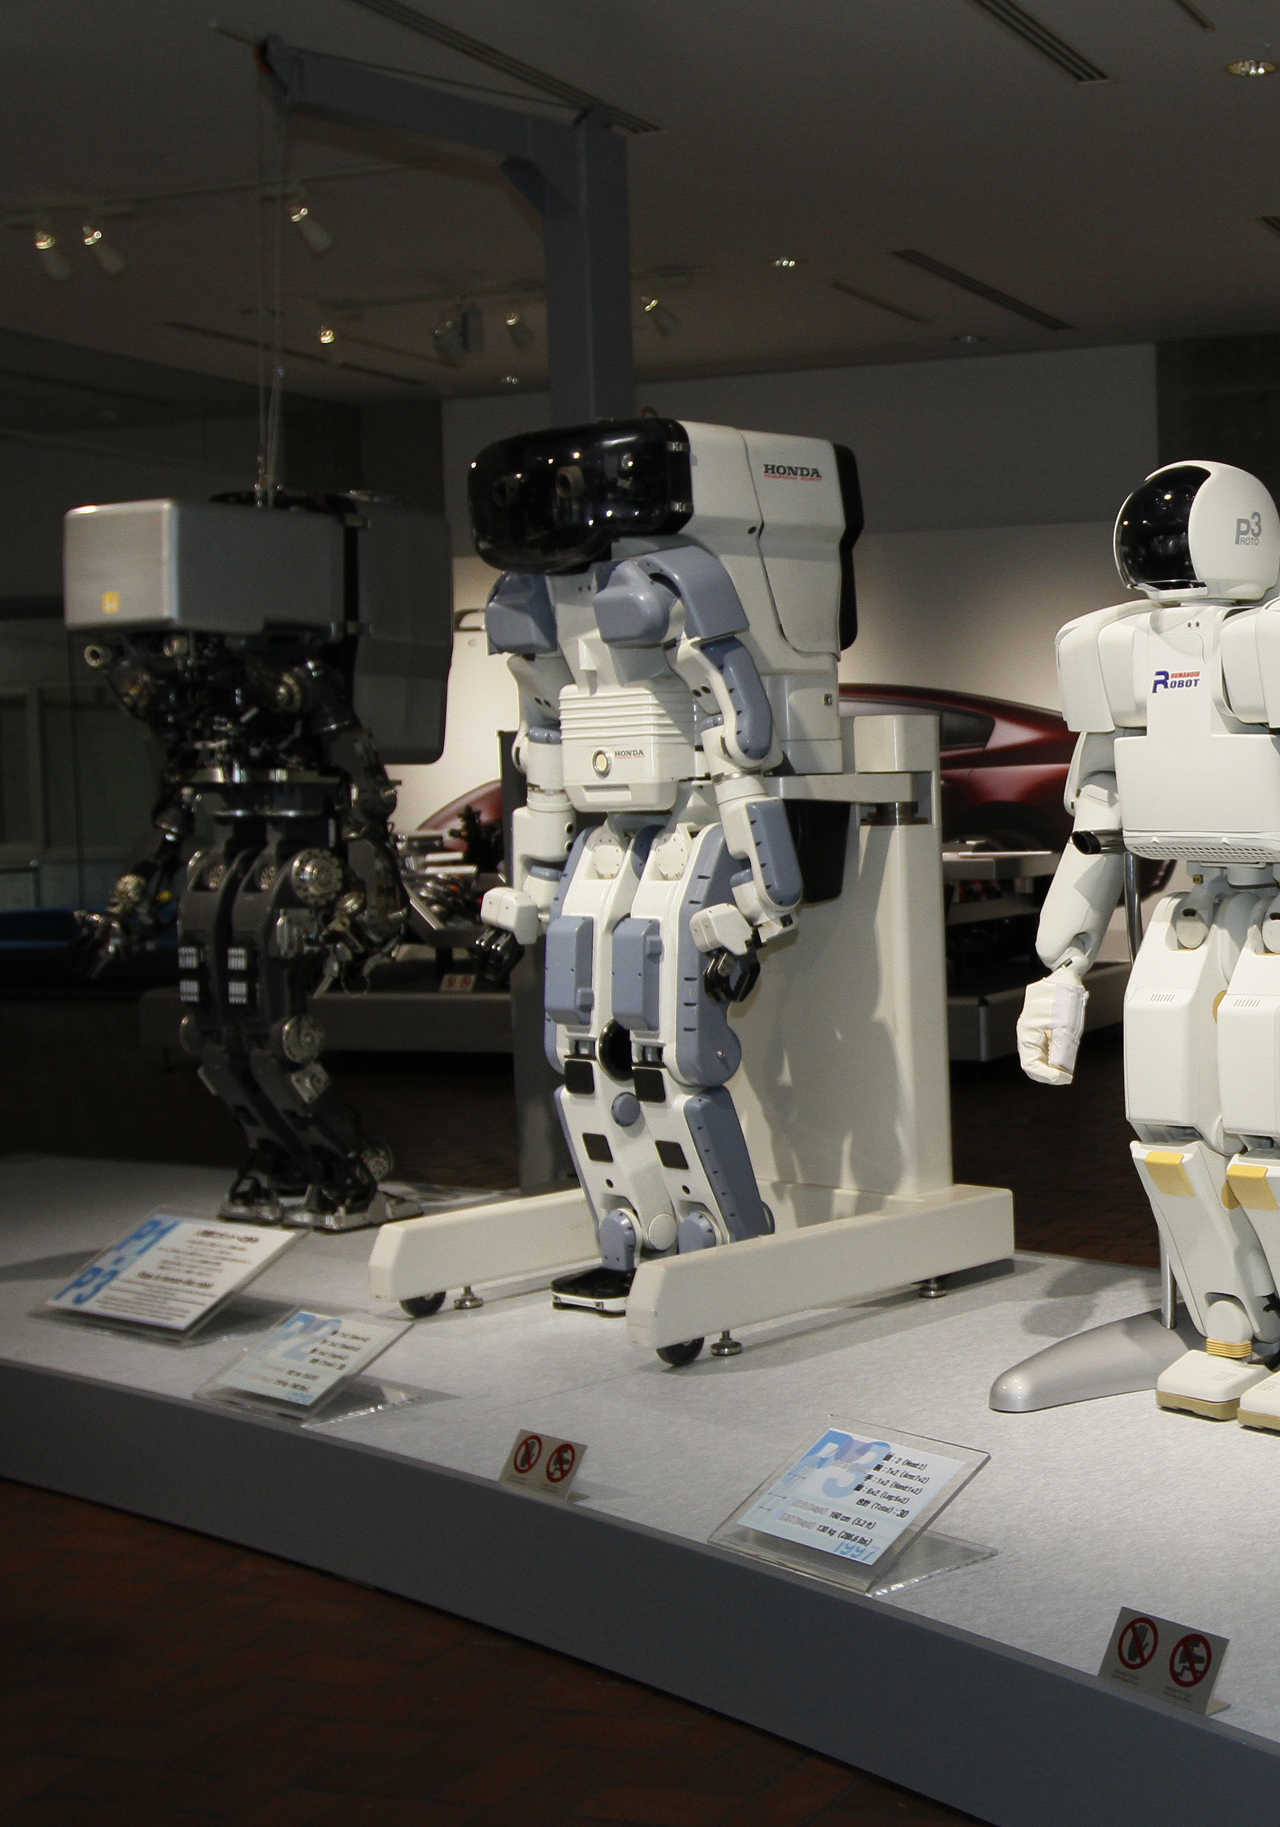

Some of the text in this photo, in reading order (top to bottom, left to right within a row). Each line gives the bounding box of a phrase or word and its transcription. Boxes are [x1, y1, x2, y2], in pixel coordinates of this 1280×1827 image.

[763, 464, 821, 478] HONDA
[1152, 670, 1200, 693] ROBOT
[614, 749, 645, 757] HONDA
